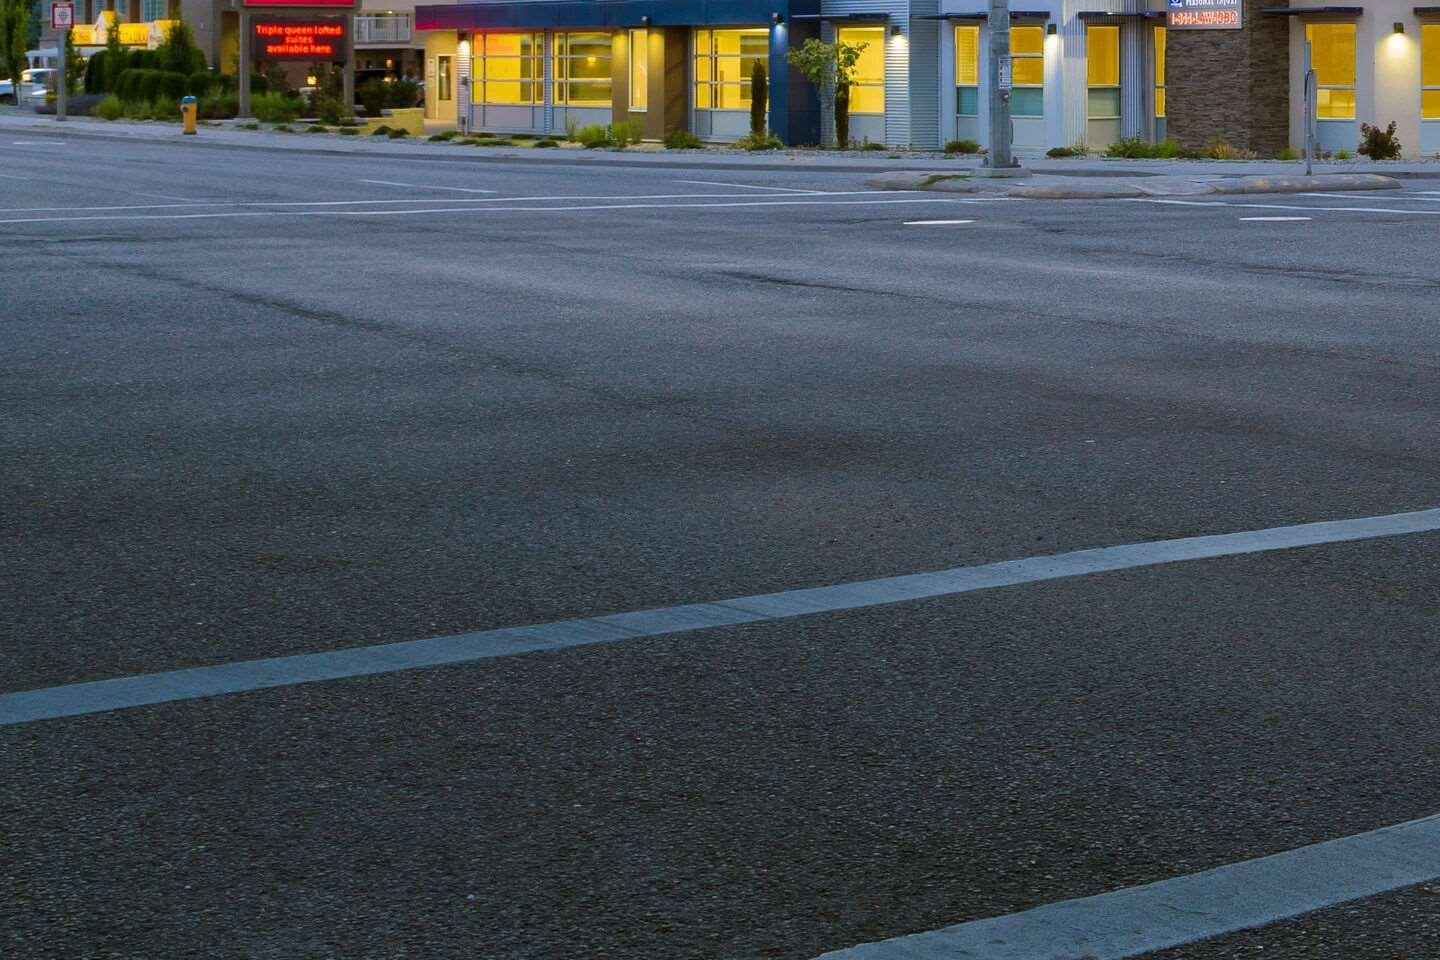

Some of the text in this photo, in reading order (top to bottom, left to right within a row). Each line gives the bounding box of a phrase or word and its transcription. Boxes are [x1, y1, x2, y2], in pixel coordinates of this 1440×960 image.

[256, 25, 342, 36] Triple queen lofted
[285, 36, 314, 44] suites
[266, 45, 332, 54] available here
